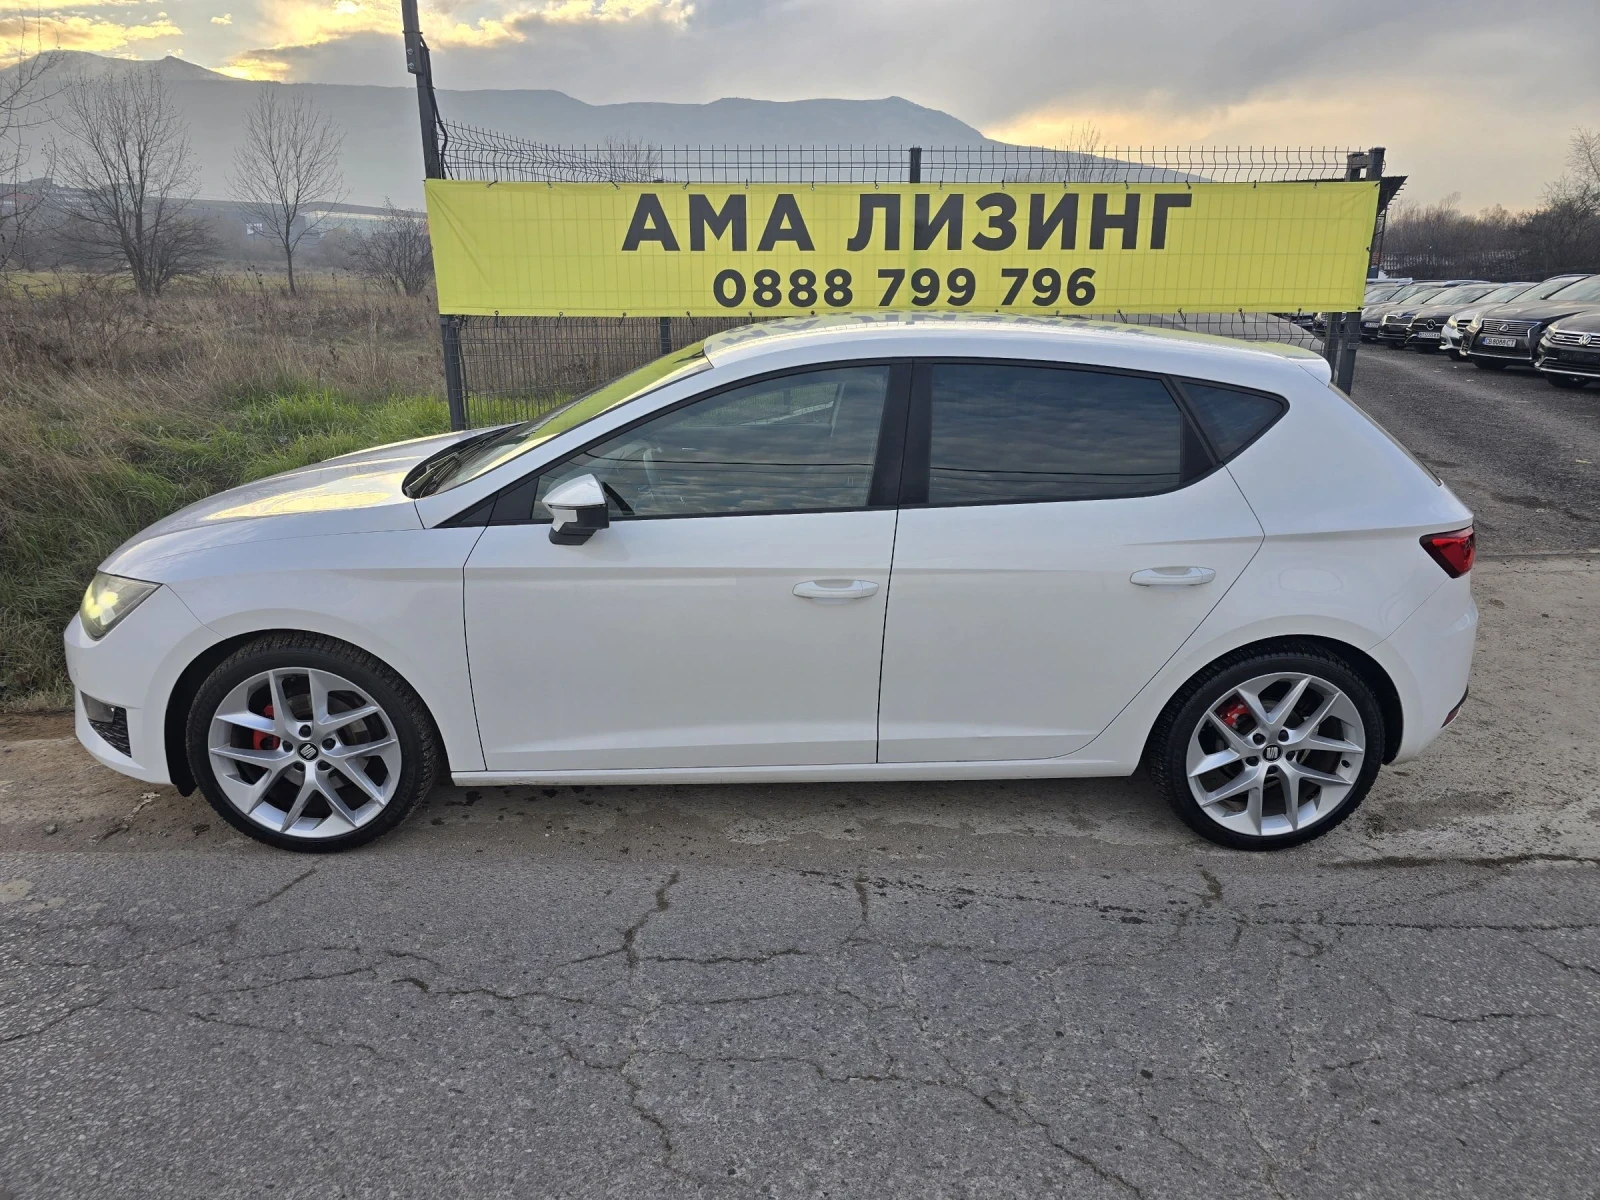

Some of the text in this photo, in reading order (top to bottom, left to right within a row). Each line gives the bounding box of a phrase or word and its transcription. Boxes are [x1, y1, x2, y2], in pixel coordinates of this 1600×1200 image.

[622, 193, 1193, 251] АМА ЛИЗИНГ
[714, 267, 1096, 307] 0888 799 796
